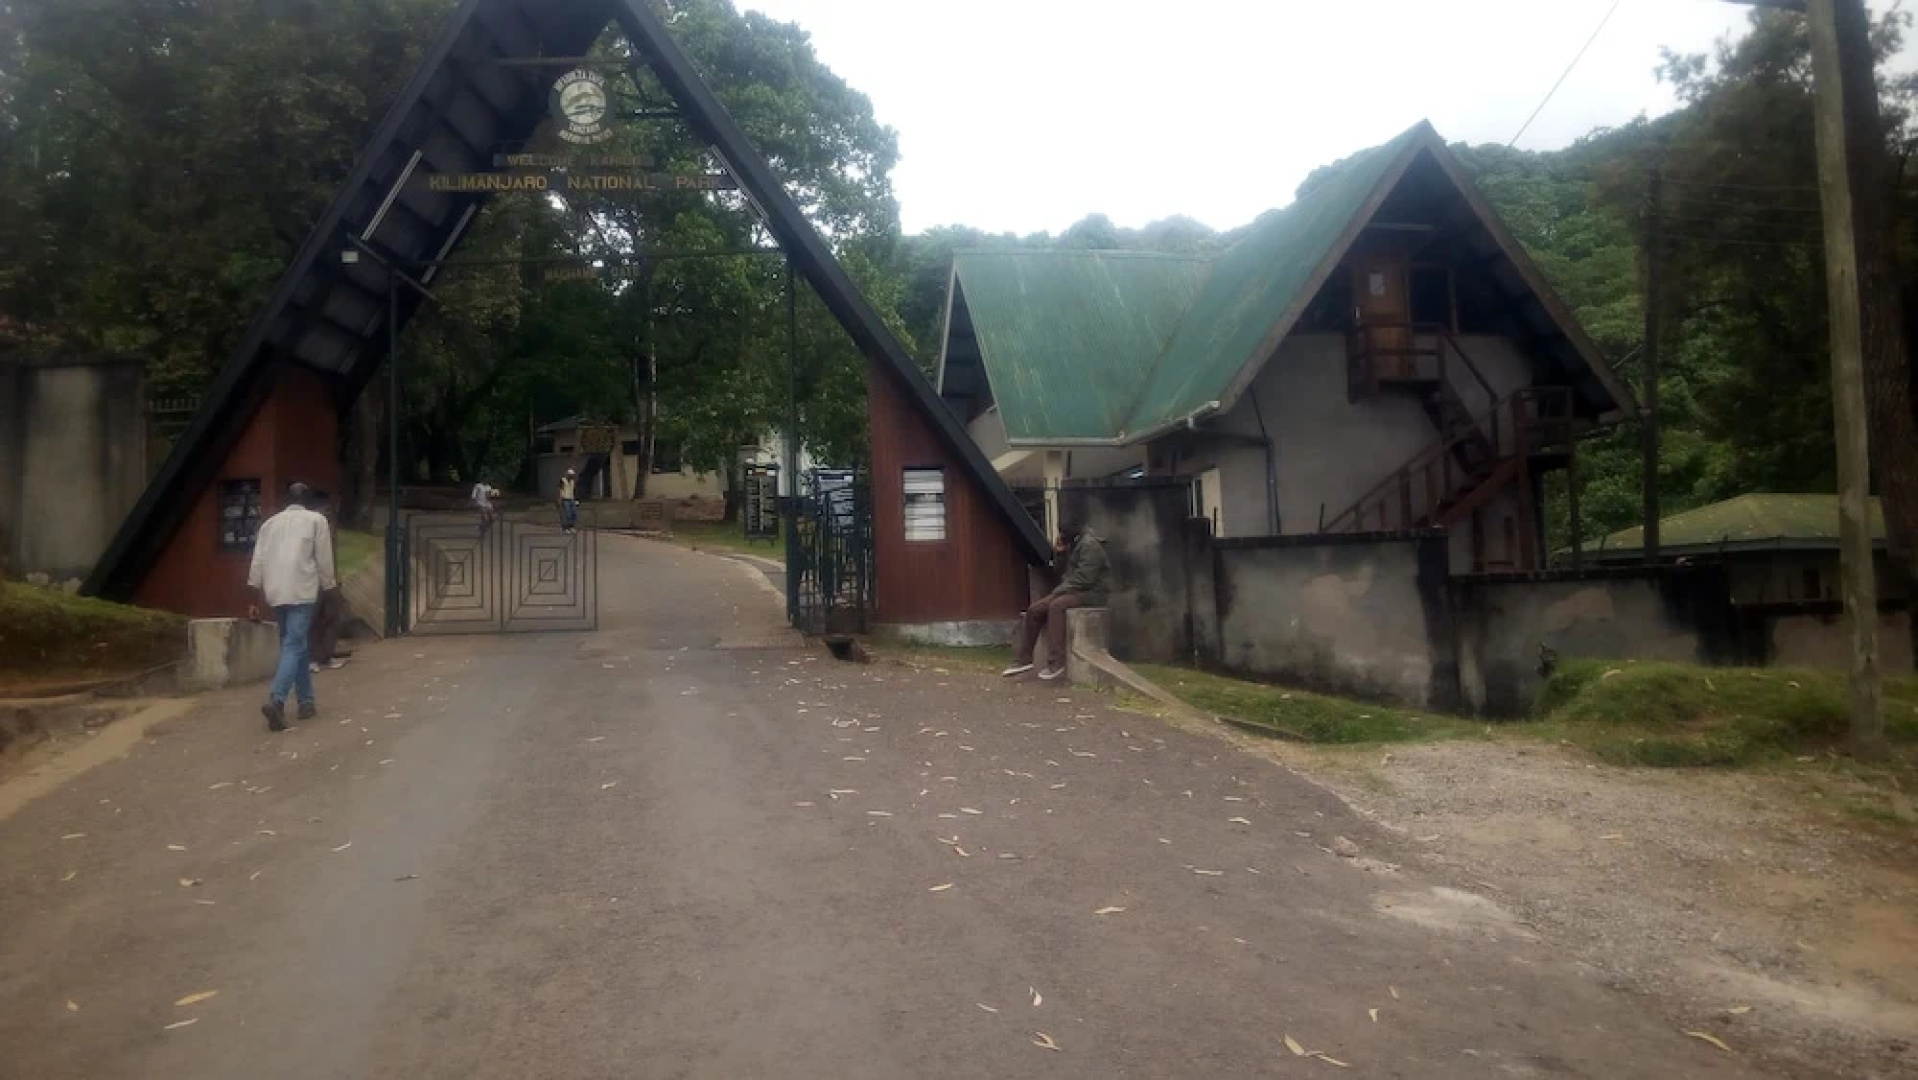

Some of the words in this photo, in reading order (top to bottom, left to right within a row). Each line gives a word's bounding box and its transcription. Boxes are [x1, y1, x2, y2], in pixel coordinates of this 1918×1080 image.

[507, 153, 576, 166] WELCOME
[428, 175, 548, 190] KILIMANJARO
[567, 176, 655, 189] NATIONAL
